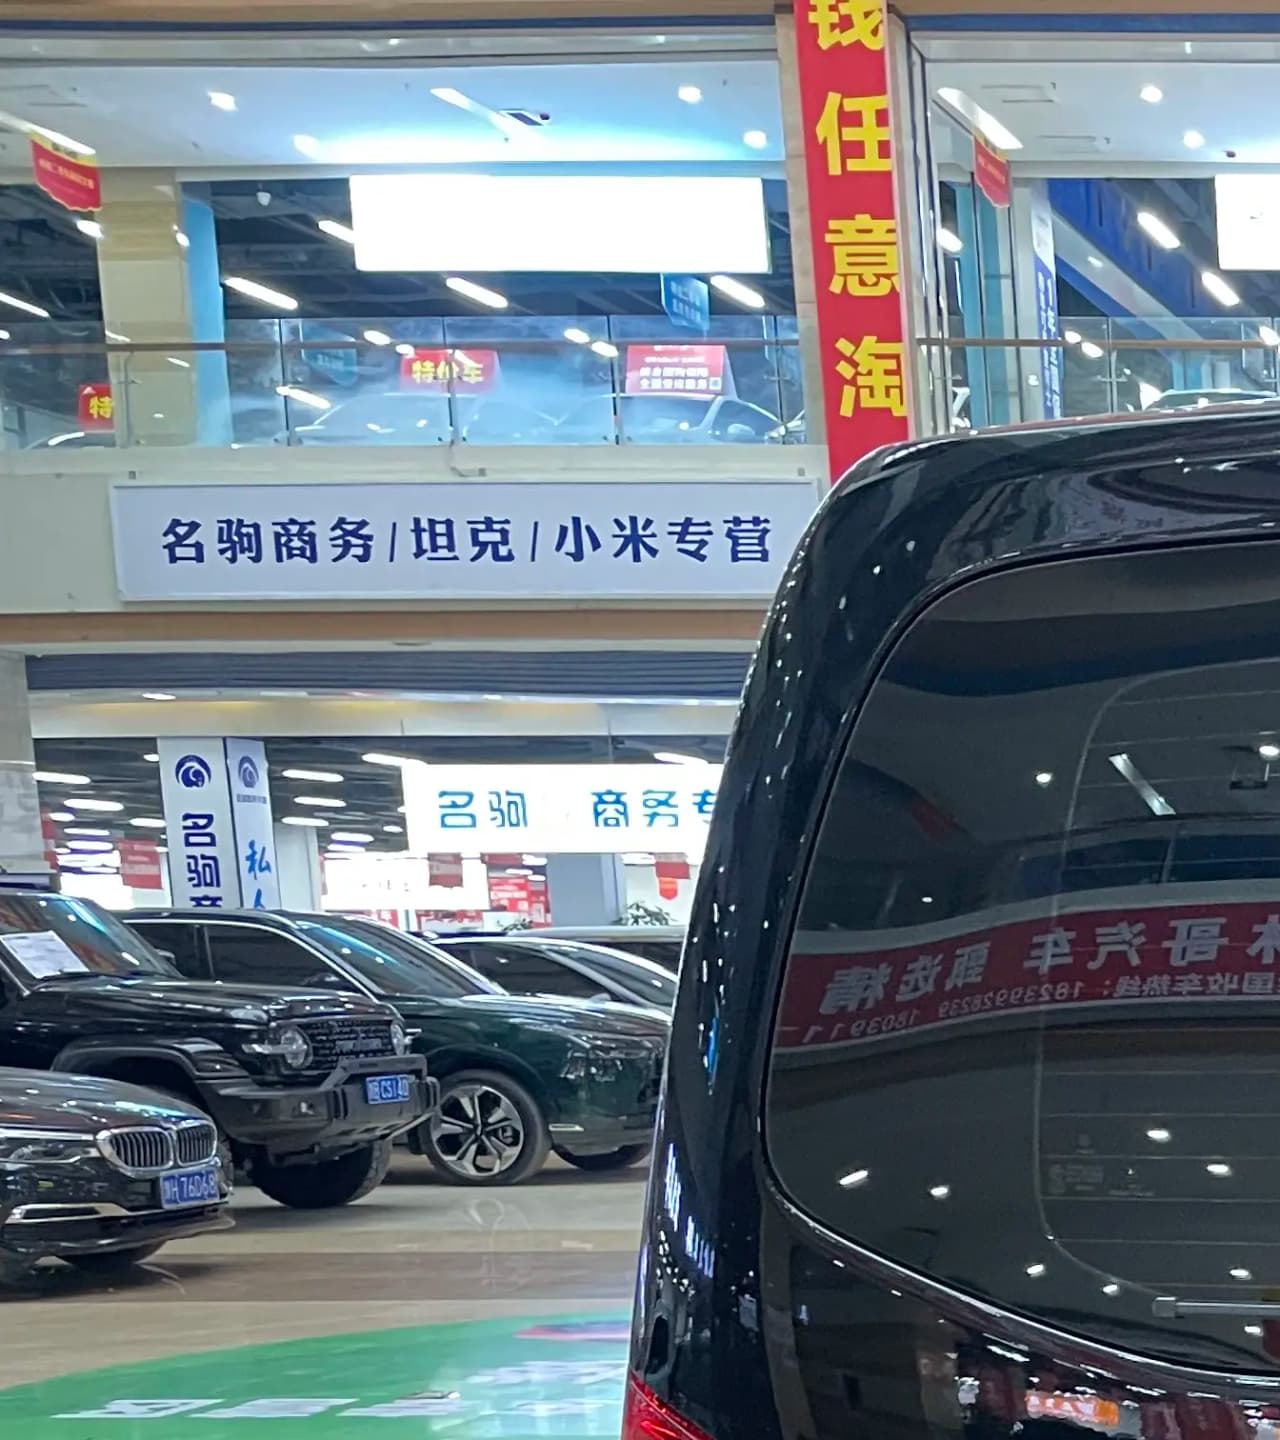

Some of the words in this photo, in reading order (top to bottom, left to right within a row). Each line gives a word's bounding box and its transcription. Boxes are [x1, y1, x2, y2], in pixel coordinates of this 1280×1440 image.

[161, 515, 773, 565] 名驹商务/坦克/小米专营
[438, 789, 528, 829] 名驹
